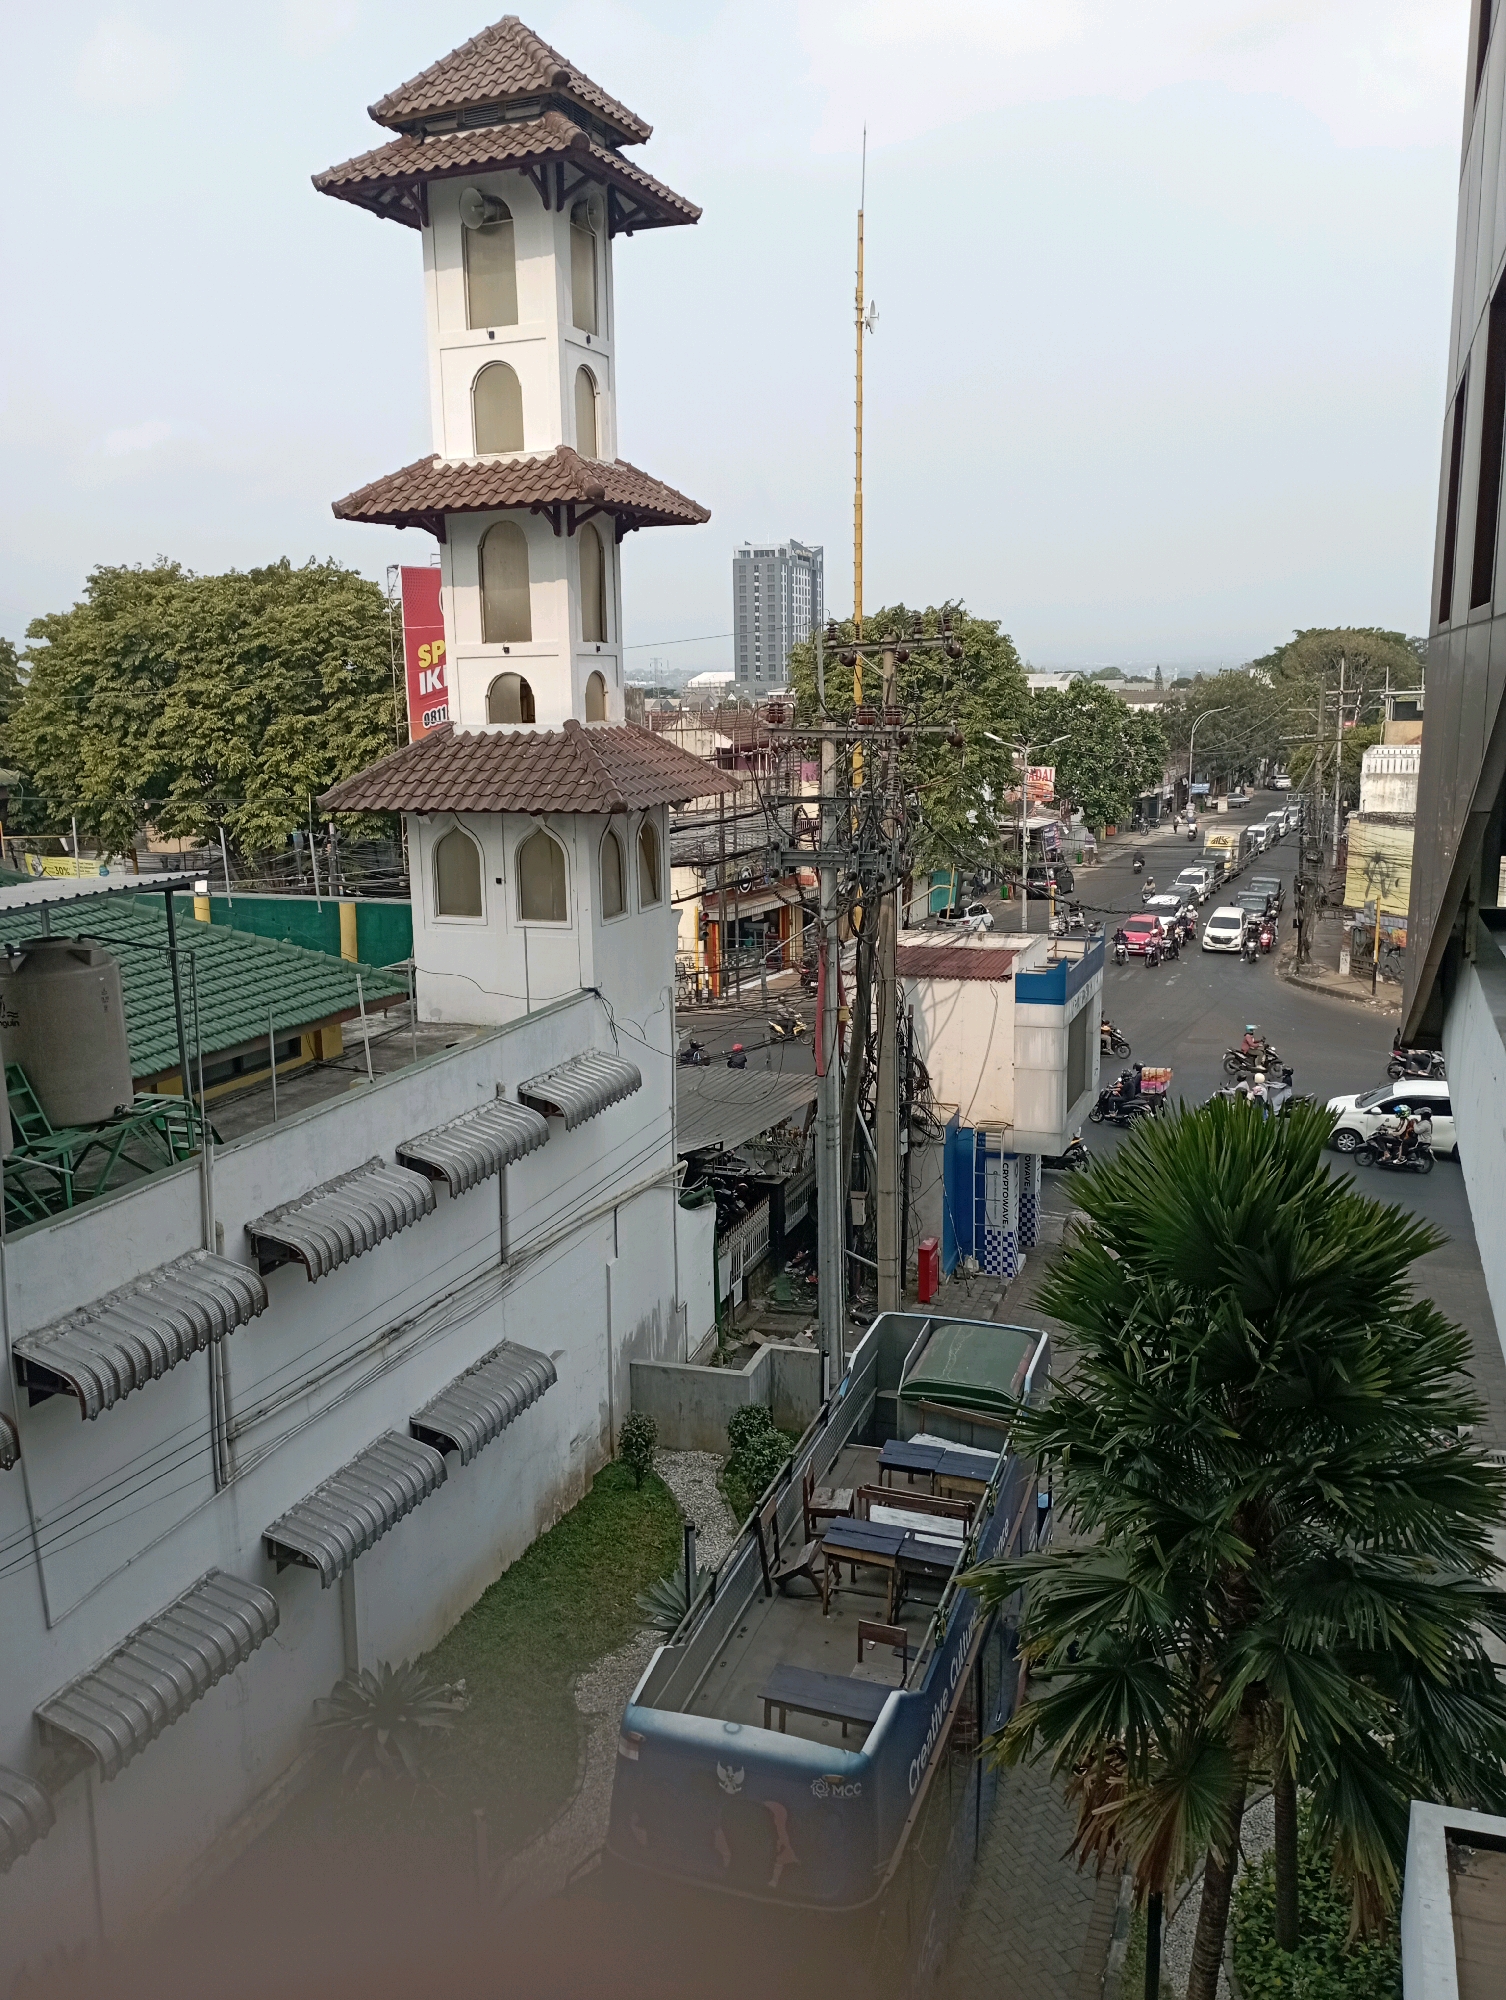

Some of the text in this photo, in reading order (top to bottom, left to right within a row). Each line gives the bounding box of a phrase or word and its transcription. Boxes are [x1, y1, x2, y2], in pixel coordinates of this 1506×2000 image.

[423, 705, 447, 727] 0811
[1026, 768, 1053, 782] ADAI
[0, 1018, 20, 1029] guin
[908, 1687, 949, 1796] Creative
[831, 1782, 862, 1797] MCC
